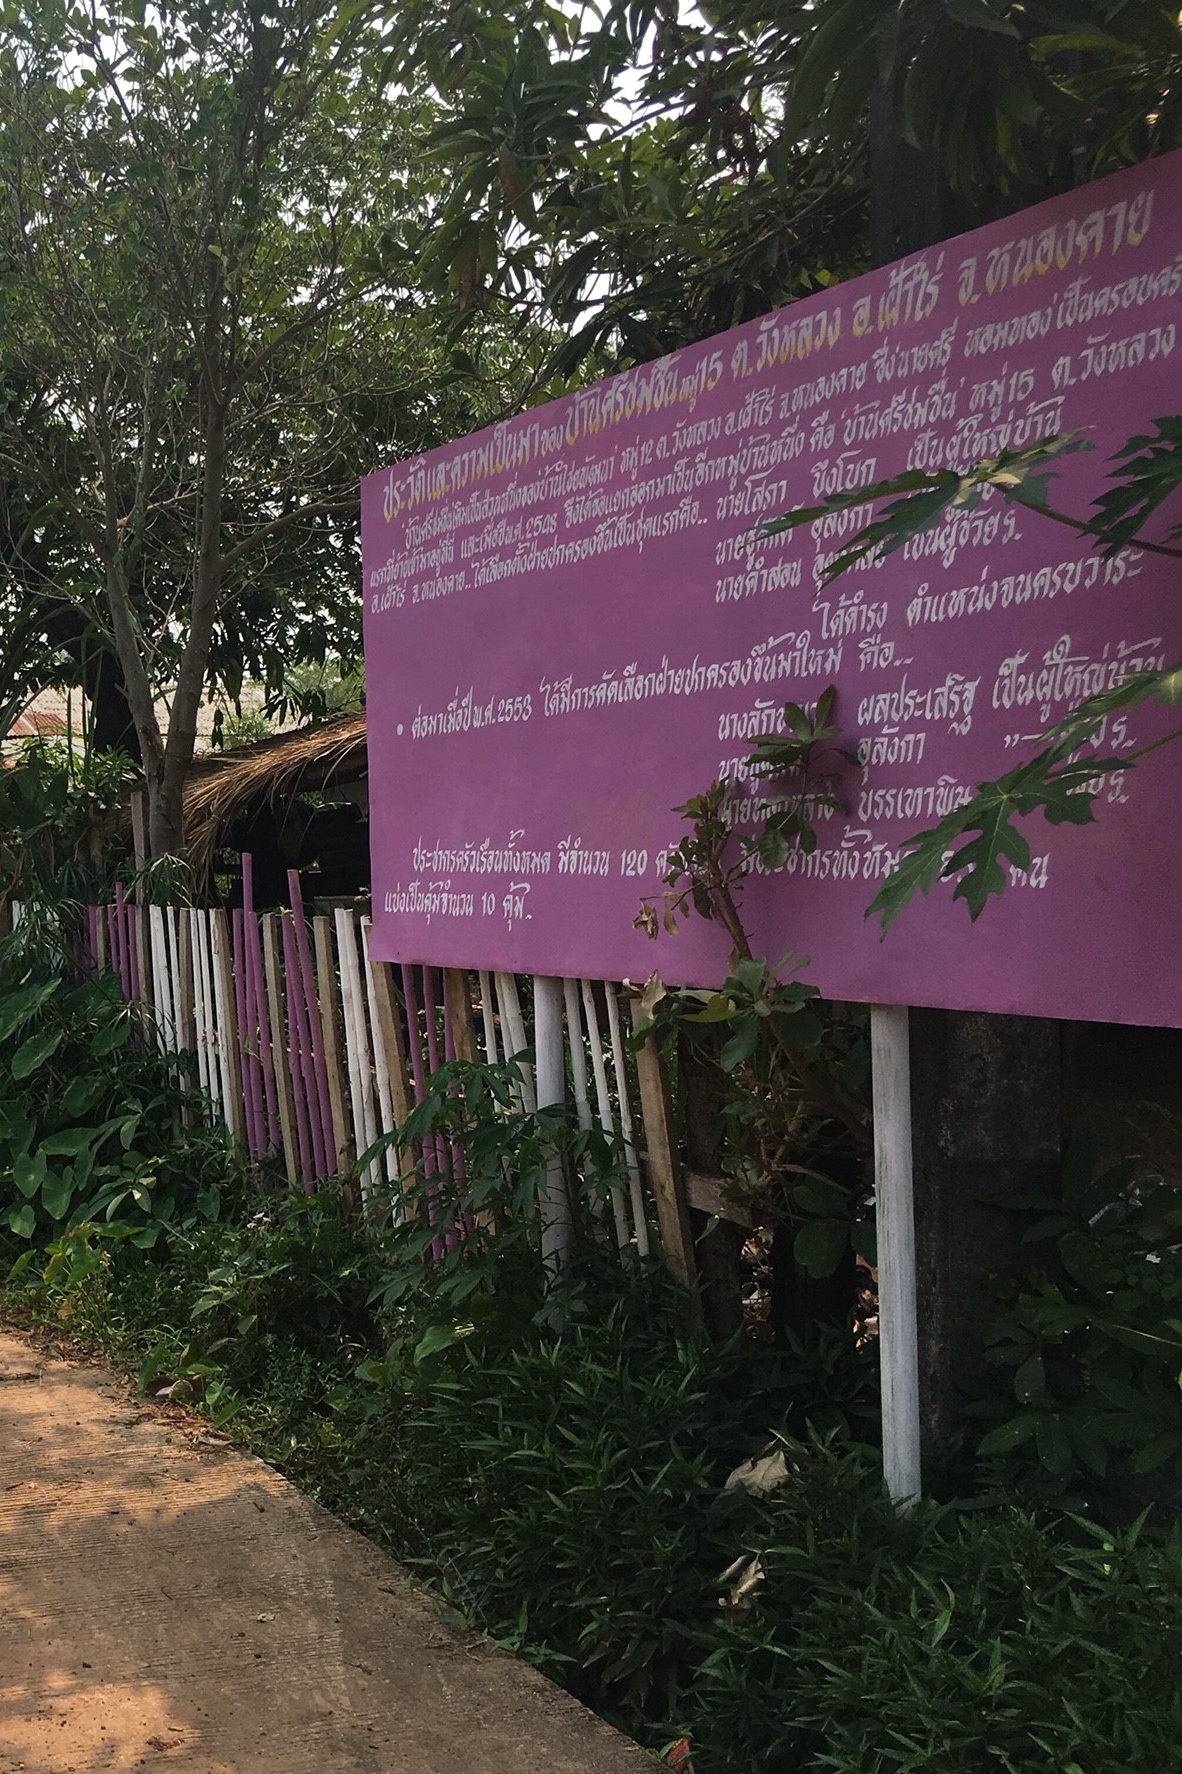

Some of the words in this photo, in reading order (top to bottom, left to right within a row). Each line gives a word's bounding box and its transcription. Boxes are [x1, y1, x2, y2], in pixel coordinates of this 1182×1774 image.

[382, 420, 541, 524] ประวัติและความเป็นมา
[729, 306, 843, 382] ต.วังหลวง
[851, 250, 946, 339] อ.เฝ้าไร่
[957, 189, 1155, 307] จ.หนองคาย
[1050, 323, 1178, 391] ต.วังหลวง
[654, 415, 723, 461] ต.วังหลวง
[778, 359, 870, 421] จ.หนองคาย
[619, 848, 650, 878] 120
[481, 894, 496, 915] 10
